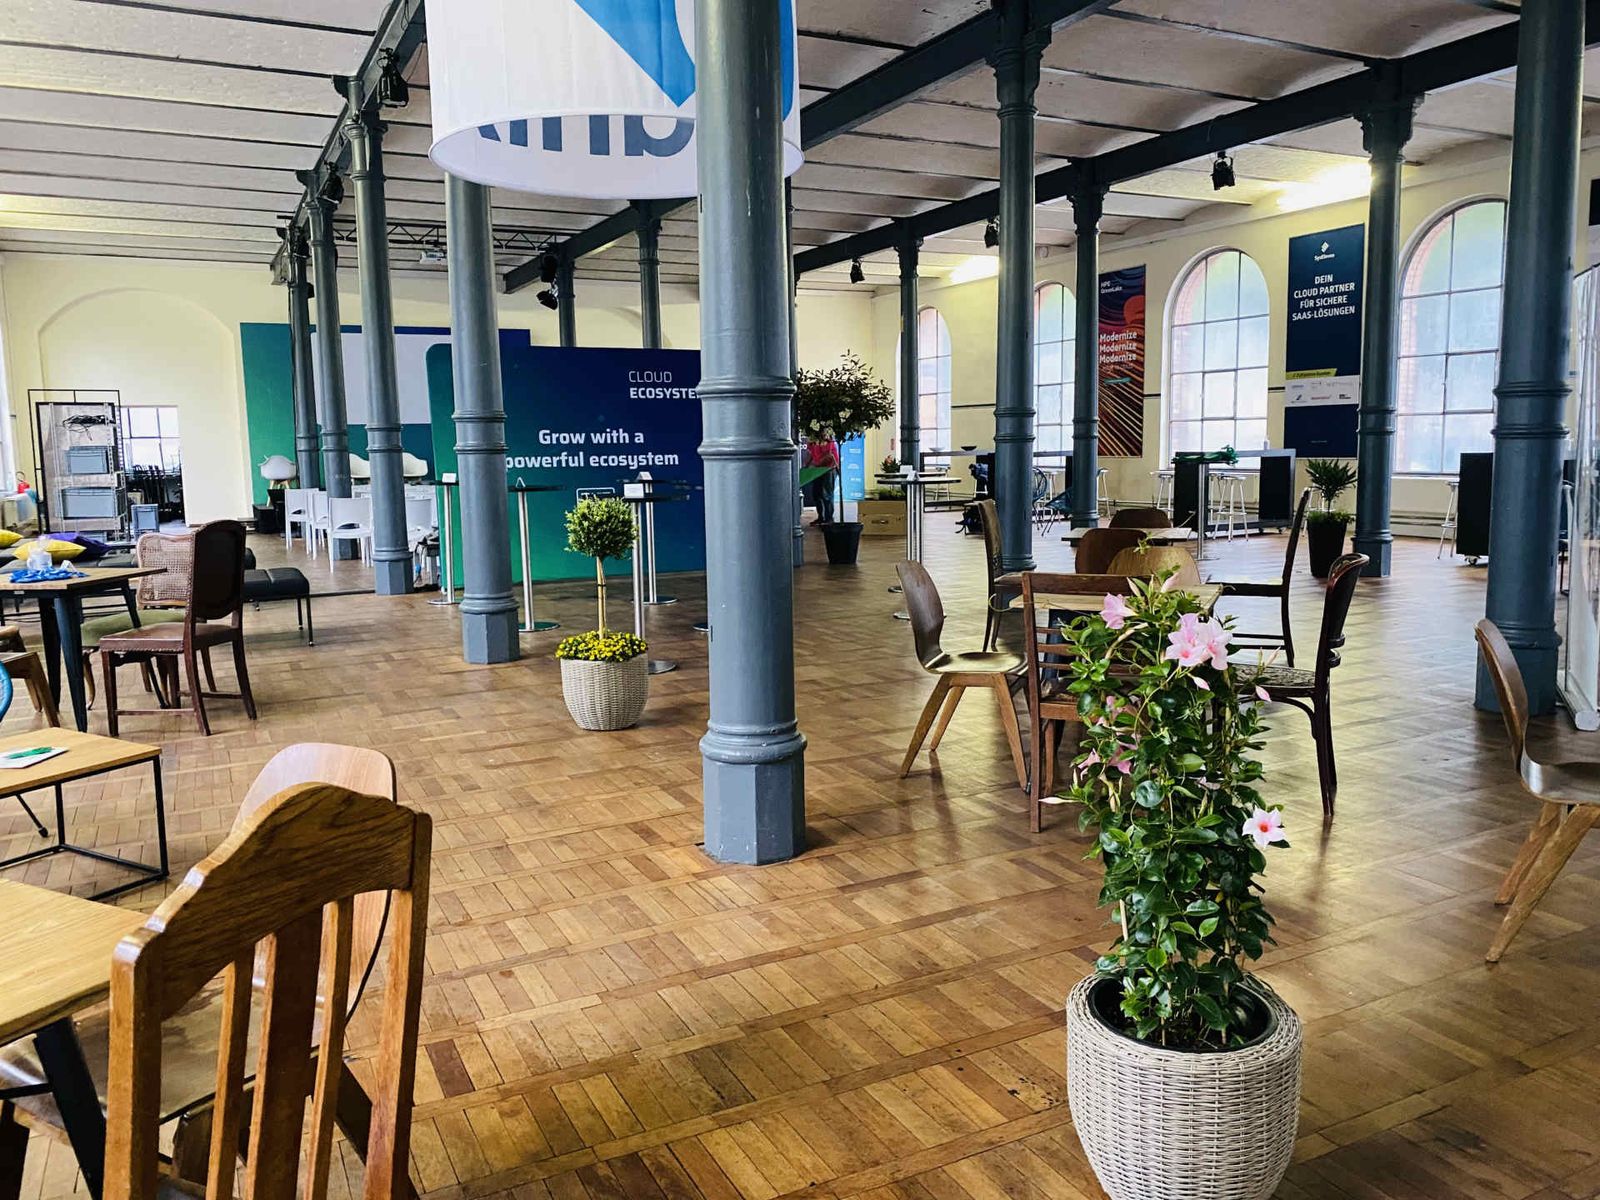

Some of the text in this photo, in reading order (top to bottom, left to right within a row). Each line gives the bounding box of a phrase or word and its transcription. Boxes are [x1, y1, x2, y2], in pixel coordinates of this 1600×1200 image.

[1314, 274, 1333, 284] DEIN
[1293, 282, 1355, 299] CLOUD PARTNER
[1300, 294, 1348, 309] FÜR SICHERE
[1292, 306, 1355, 321] SAAS-LÖSUNGEN
[1099, 331, 1137, 343] Modernize
[1099, 342, 1137, 354] Modernize
[1099, 352, 1137, 364] Modernize
[628, 371, 672, 383] CLOUD
[629, 387, 698, 400] ECOSYSTE
[538, 428, 644, 445] Grow with a
[506, 451, 679, 472] powerful ecosystem
